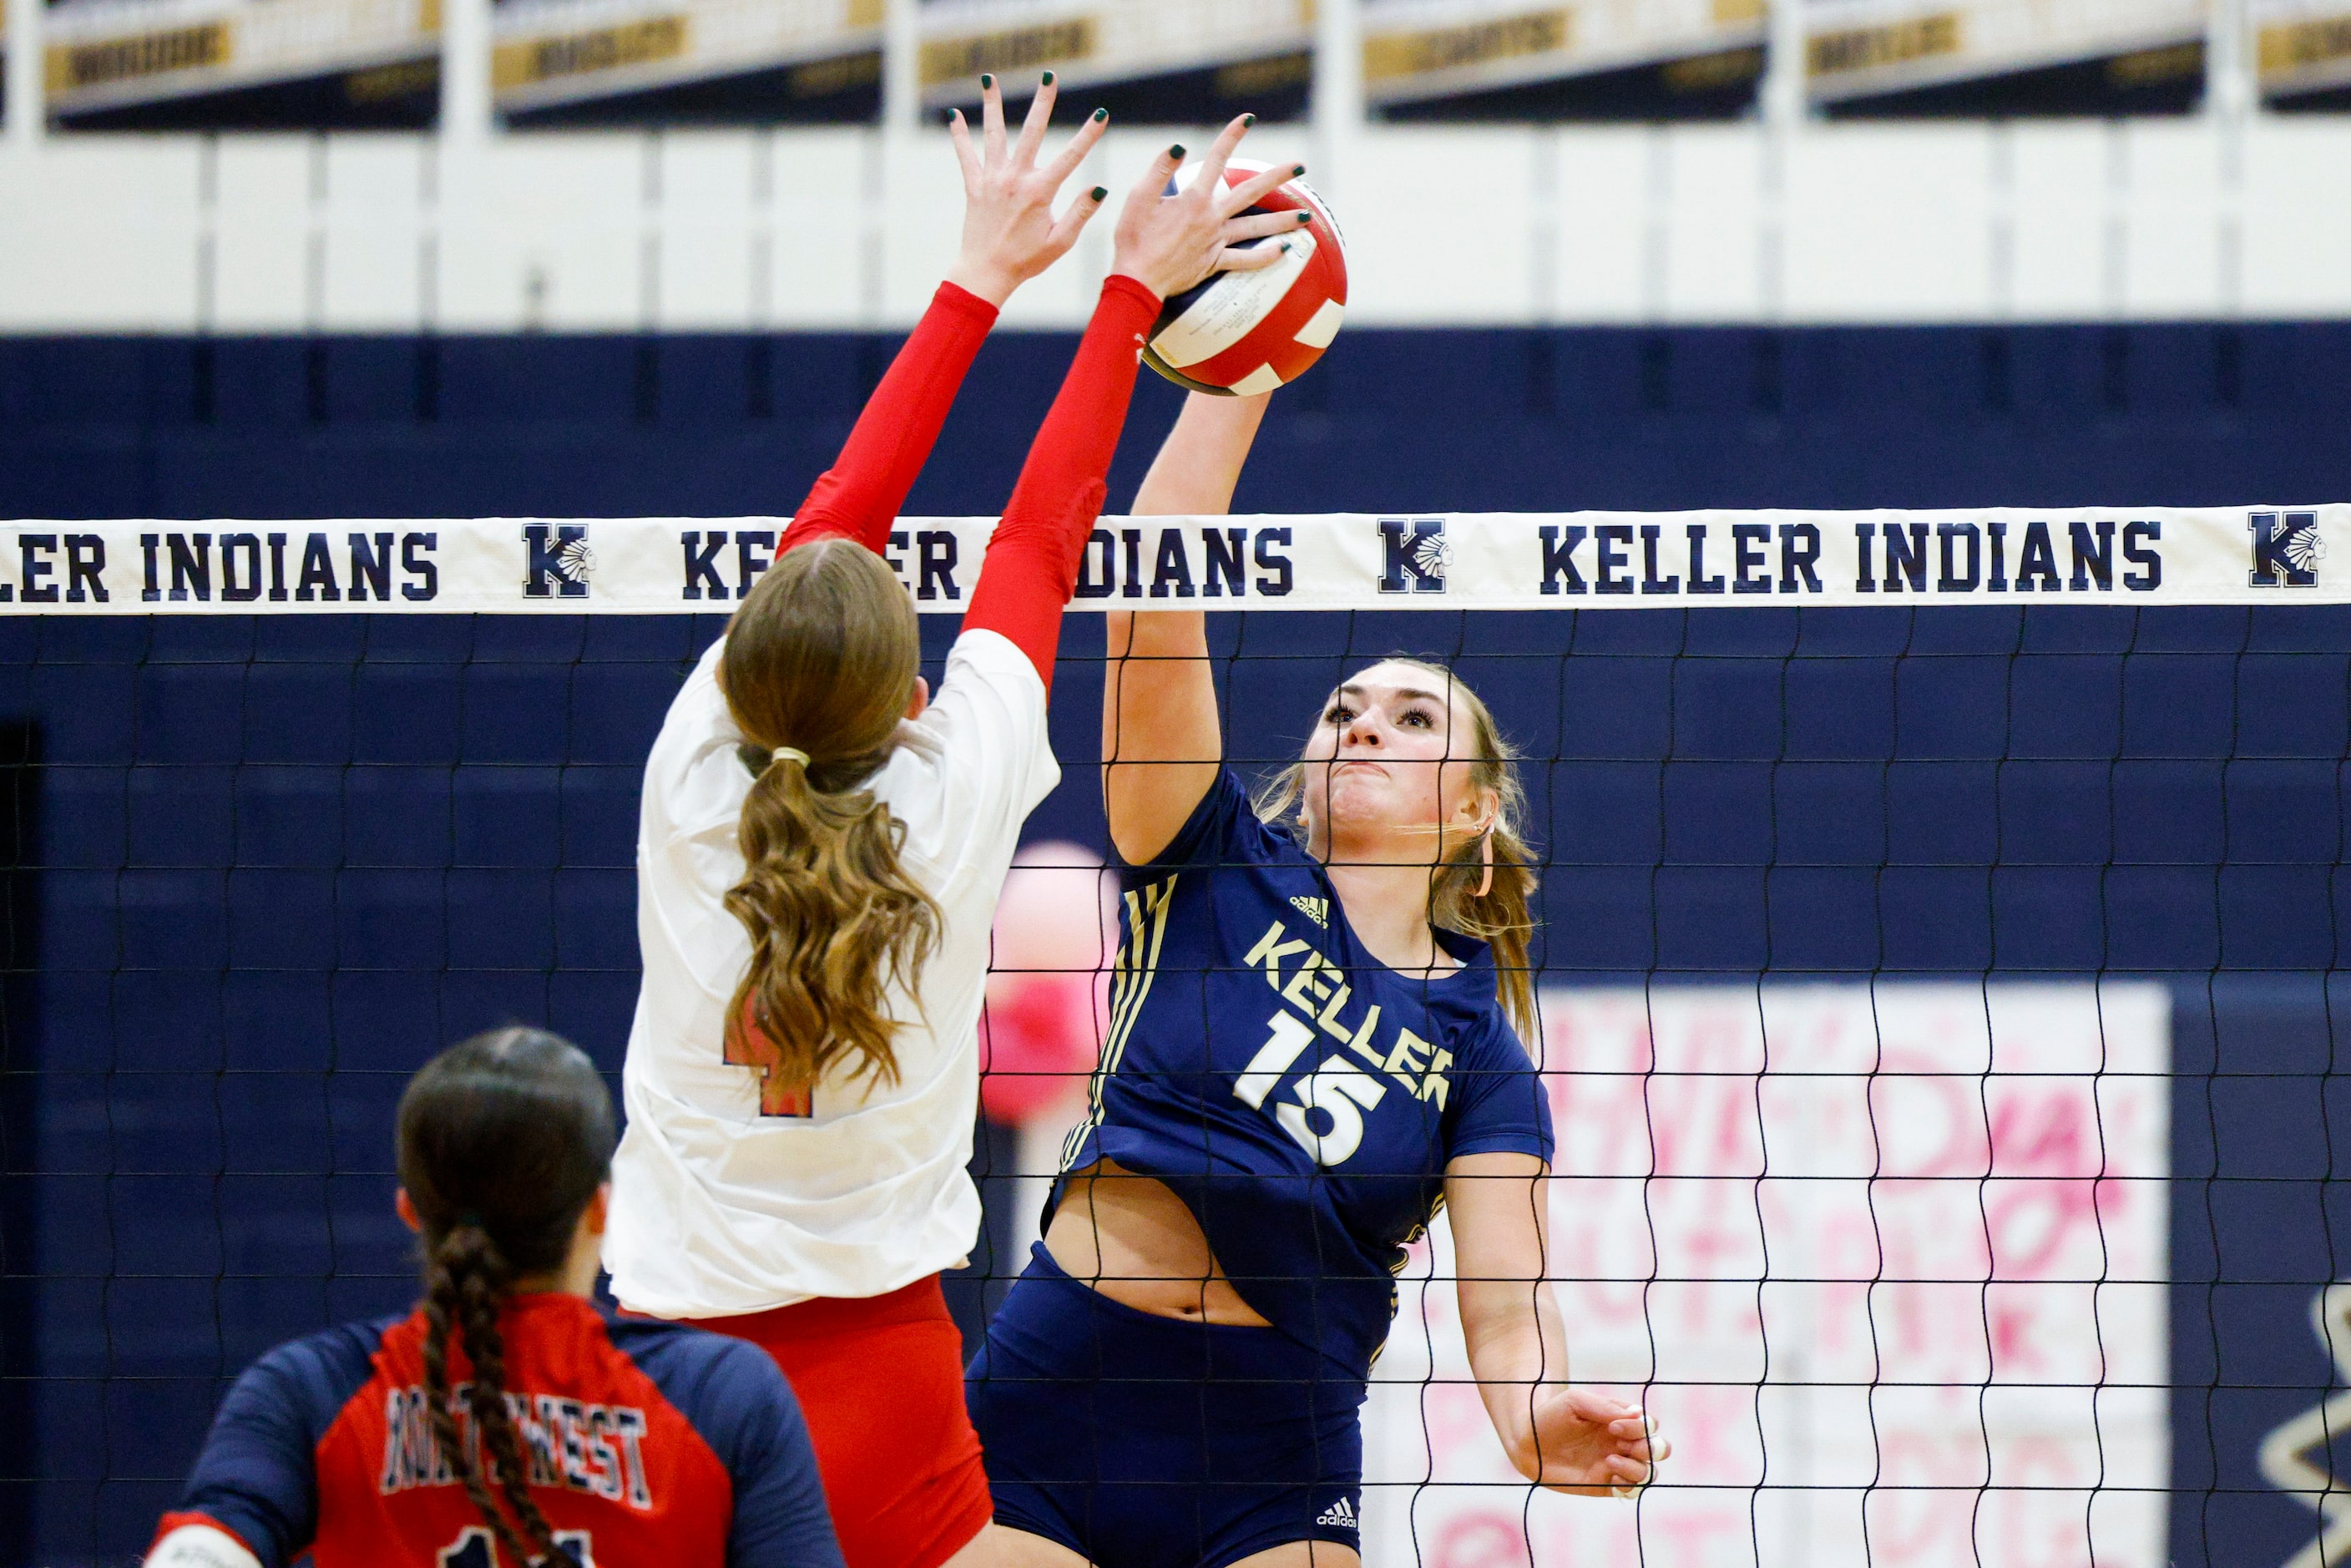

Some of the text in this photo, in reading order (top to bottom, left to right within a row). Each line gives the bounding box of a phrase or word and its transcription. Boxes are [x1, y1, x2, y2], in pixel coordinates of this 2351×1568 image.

[140, 533, 437, 602] INDIANS
[522, 523, 589, 599] K
[680, 527, 1292, 599] KEER DIANS
[1378, 518, 1446, 594] K
[1540, 521, 2161, 594] KELLER INDIANS
[2248, 511, 2318, 588] K
[1289, 896, 1329, 929] adidas
[1242, 919, 1454, 1113] KELLER
[1232, 1008, 1388, 1166] 15
[379, 1380, 654, 1511] NTWEST
[1317, 1513, 1358, 1529] adidas
